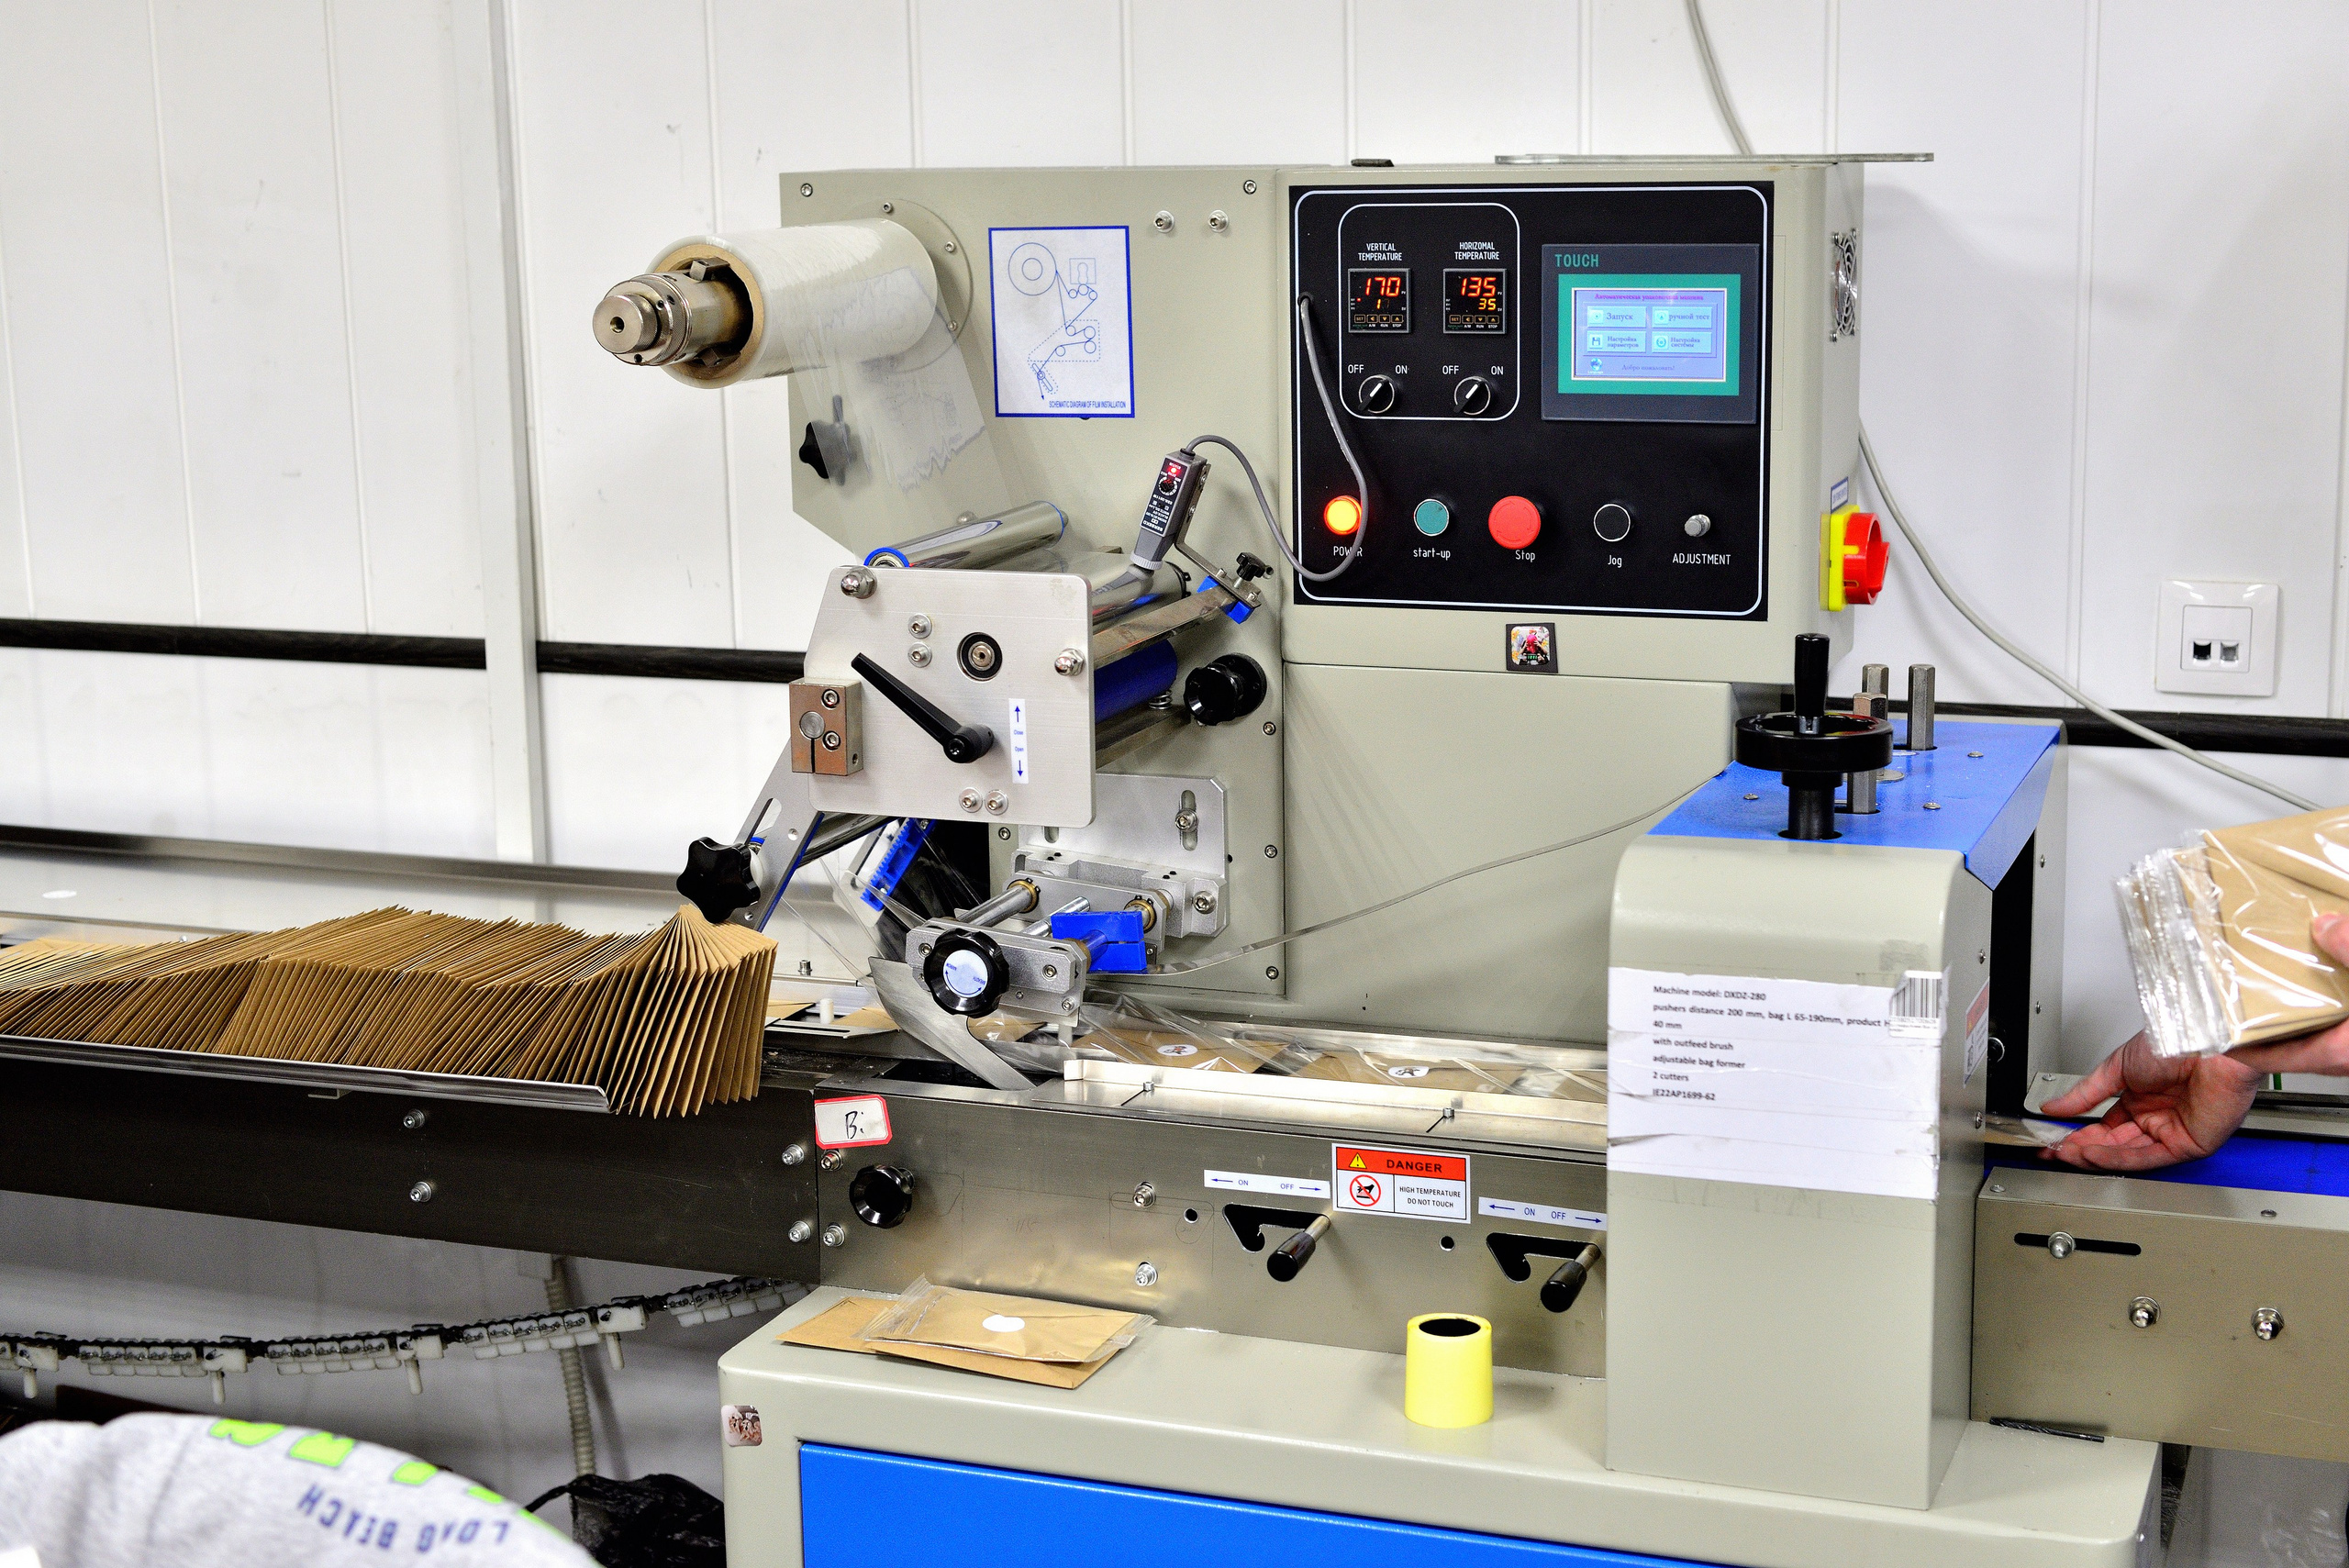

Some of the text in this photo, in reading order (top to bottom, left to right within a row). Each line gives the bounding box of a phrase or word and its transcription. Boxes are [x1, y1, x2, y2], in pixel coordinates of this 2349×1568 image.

[1366, 242, 1396, 251] VERTICAL
[1358, 252, 1402, 261] TEMPERATURE
[1454, 251, 1499, 261] TEMPERATURE
[1554, 253, 1599, 268] TOUCH
[1365, 276, 1401, 297] 170
[1461, 276, 1497, 297] 135
[1478, 297, 1497, 311] 35
[1606, 312, 1633, 322] Запуск
[1668, 313, 1694, 322] ручной
[1348, 364, 1364, 374] OFF
[1395, 364, 1408, 374] ON
[1442, 365, 1459, 375] OFF
[1490, 365, 1503, 375] ON
[1413, 547, 1451, 561] start-up
[1515, 549, 1536, 562] Stop
[1672, 552, 1731, 565] ADJUSTMENT
[1608, 554, 1622, 568] Jog
[1653, 985, 1766, 1001] Machine model: DXDZ-280
[1653, 1004, 1687, 1012] pushers
[1688, 1006, 1725, 1016] distance
[1727, 1007, 1743, 1017] 200
[1745, 1010, 1765, 1018] mm,
[1767, 1011, 1784, 1021] bag
[1794, 1012, 1843, 1025] 65-190mm,
[1846, 1018, 1881, 1027] product
[1653, 1020, 1664, 1029] 40
[1653, 1038, 1733, 1050] with outfeed brush
[1653, 1054, 1745, 1068] adjustable bag former
[1653, 1071, 1689, 1082] 2 cutters
[1386, 1159, 1442, 1173] DANGER
[1280, 1183, 1295, 1191] OFF
[1399, 1185, 1461, 1198] HIGH TEMPERATURE
[1418, 1198, 1431, 1207] NOT
[1432, 1200, 1454, 1208] TOUCH
[1523, 1207, 1566, 1220] ON OFF
